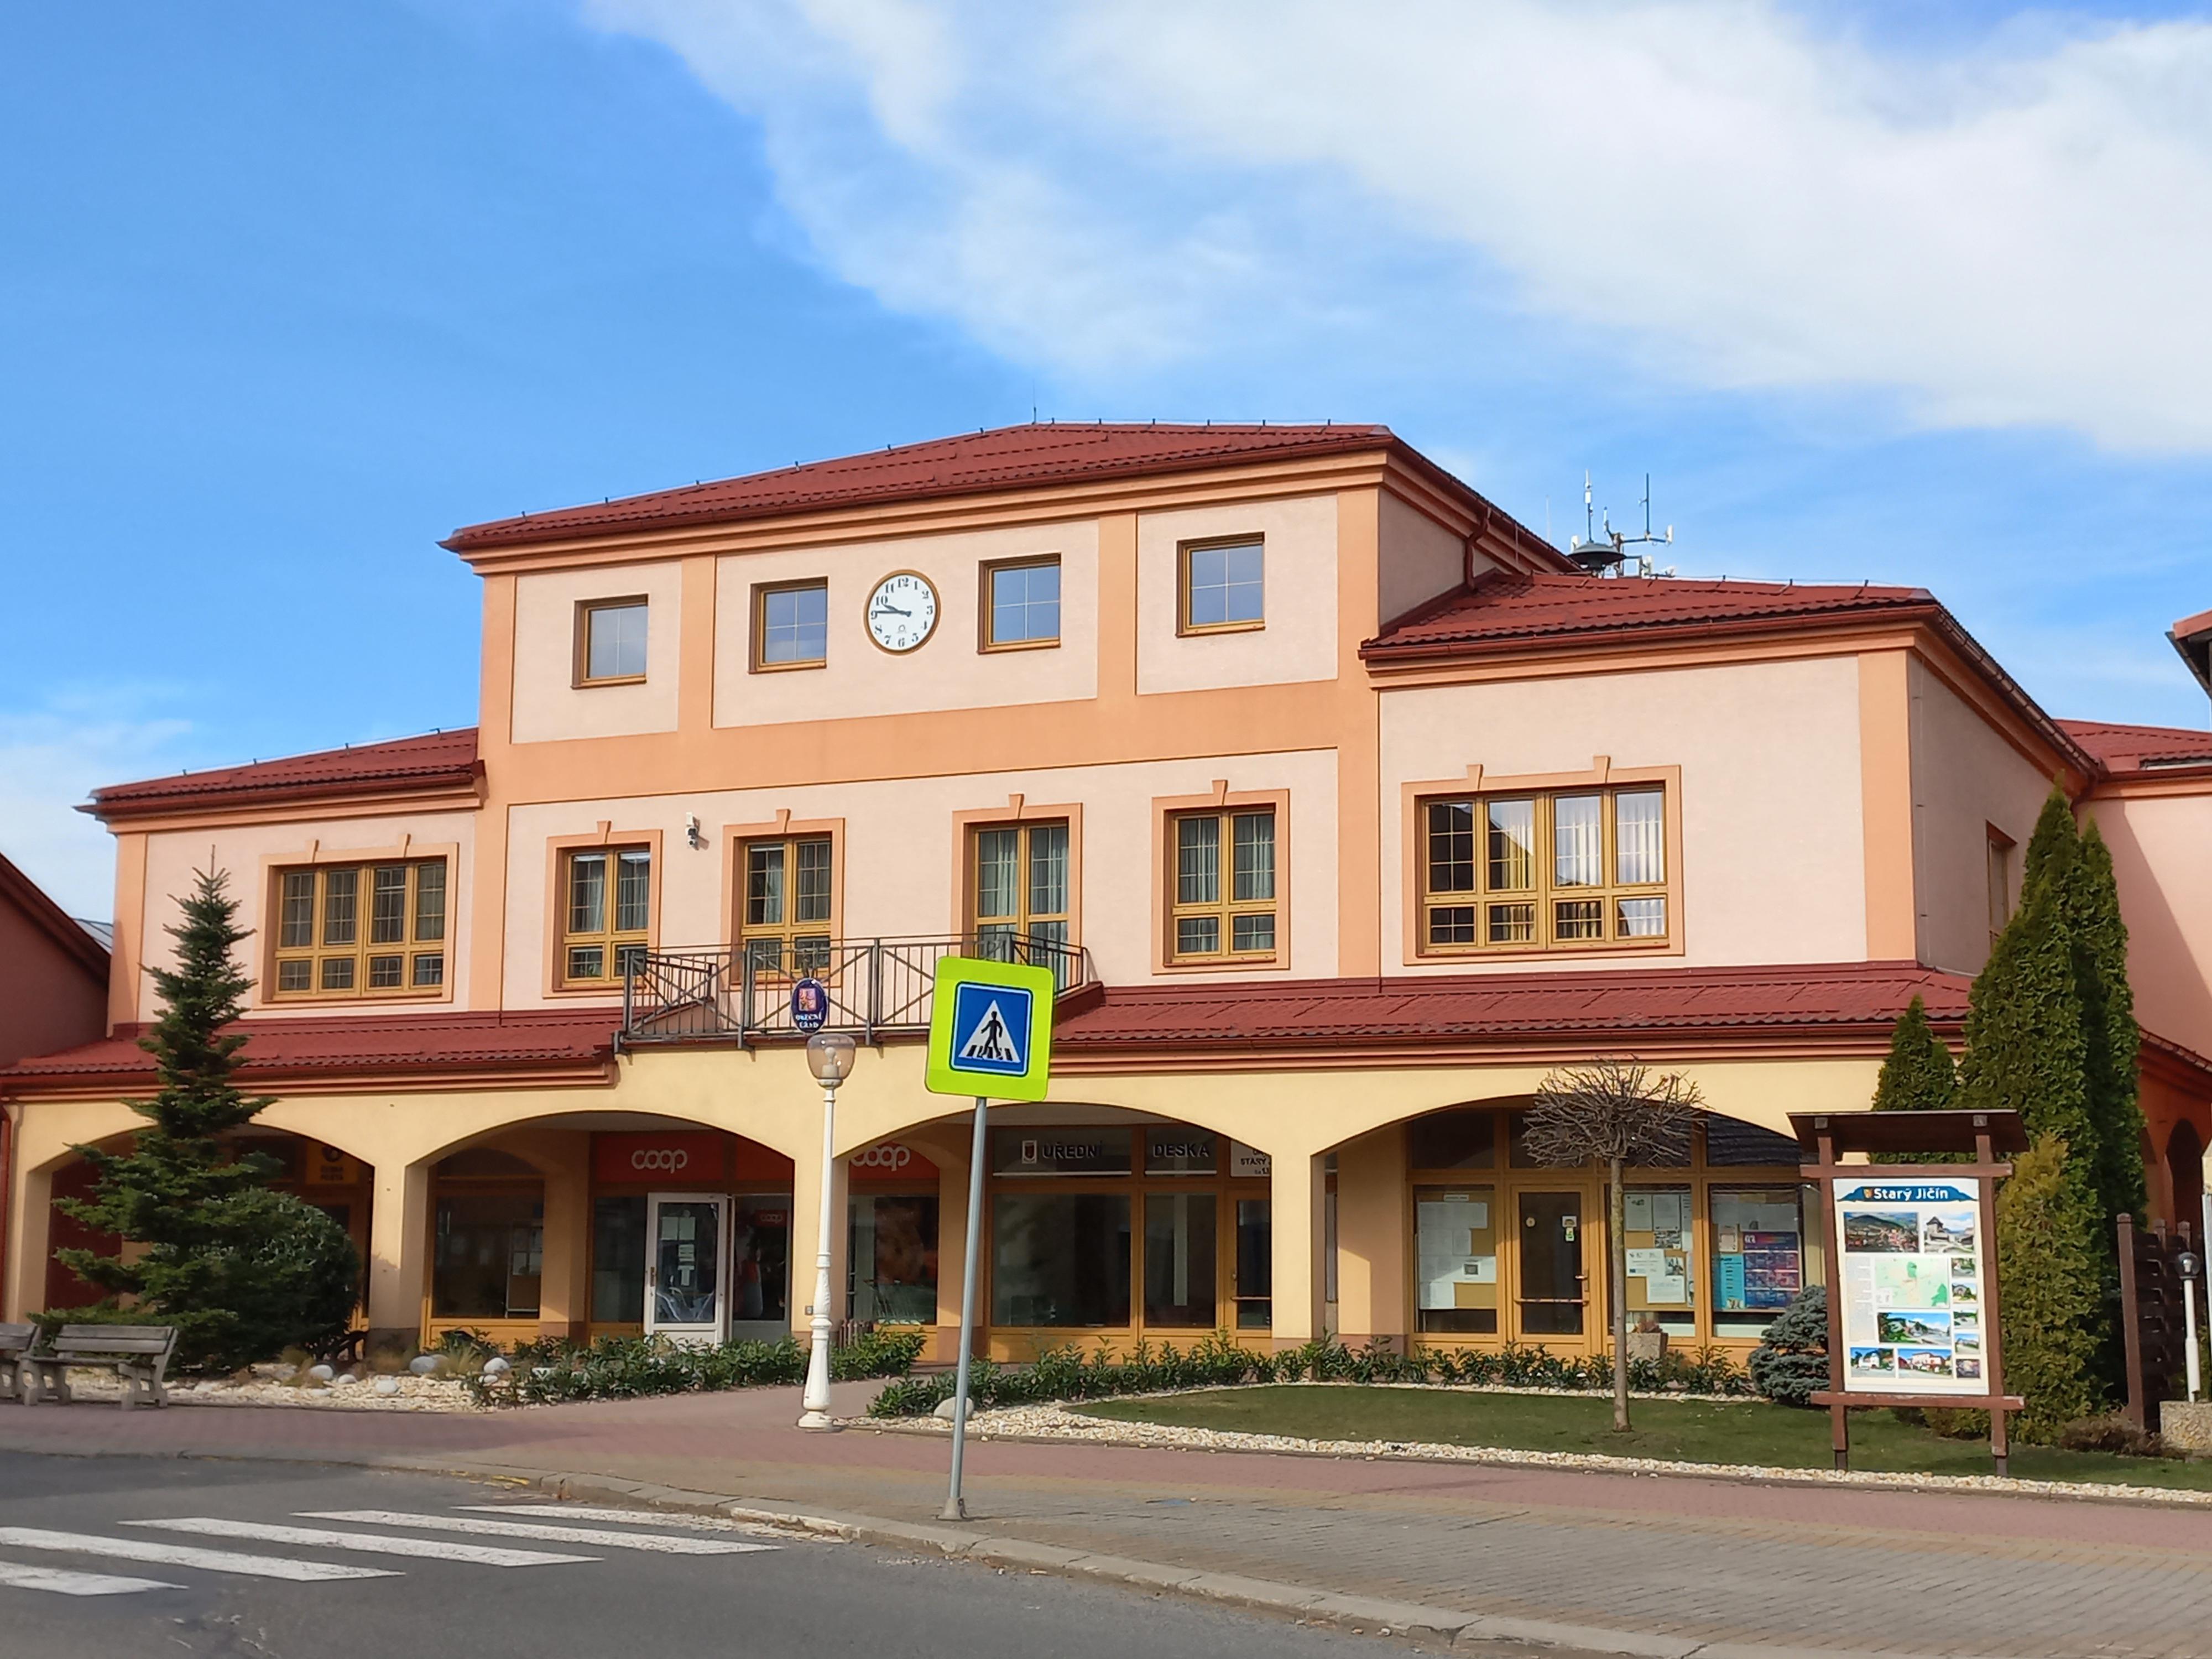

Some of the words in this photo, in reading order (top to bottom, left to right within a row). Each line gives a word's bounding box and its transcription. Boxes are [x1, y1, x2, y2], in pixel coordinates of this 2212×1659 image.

[898, 577, 909, 587] 12
[914, 581, 918, 590] 1
[885, 583, 894, 593] 11
[922, 590, 929, 599] 2
[875, 596, 888, 606] 10
[871, 611, 878, 620] 9
[926, 606, 933, 615] 3
[874, 624, 882, 634] 8
[921, 620, 927, 630] 4
[884, 635, 891, 645] 7
[898, 638, 905, 647] 6
[911, 633, 919, 642] 5
[1153, 1143, 1209, 1158] DESKA
[631, 1149, 687, 1173] coop
[1874, 1188, 1912, 1201] Starý
[1916, 1187, 1948, 1199] Jičín
